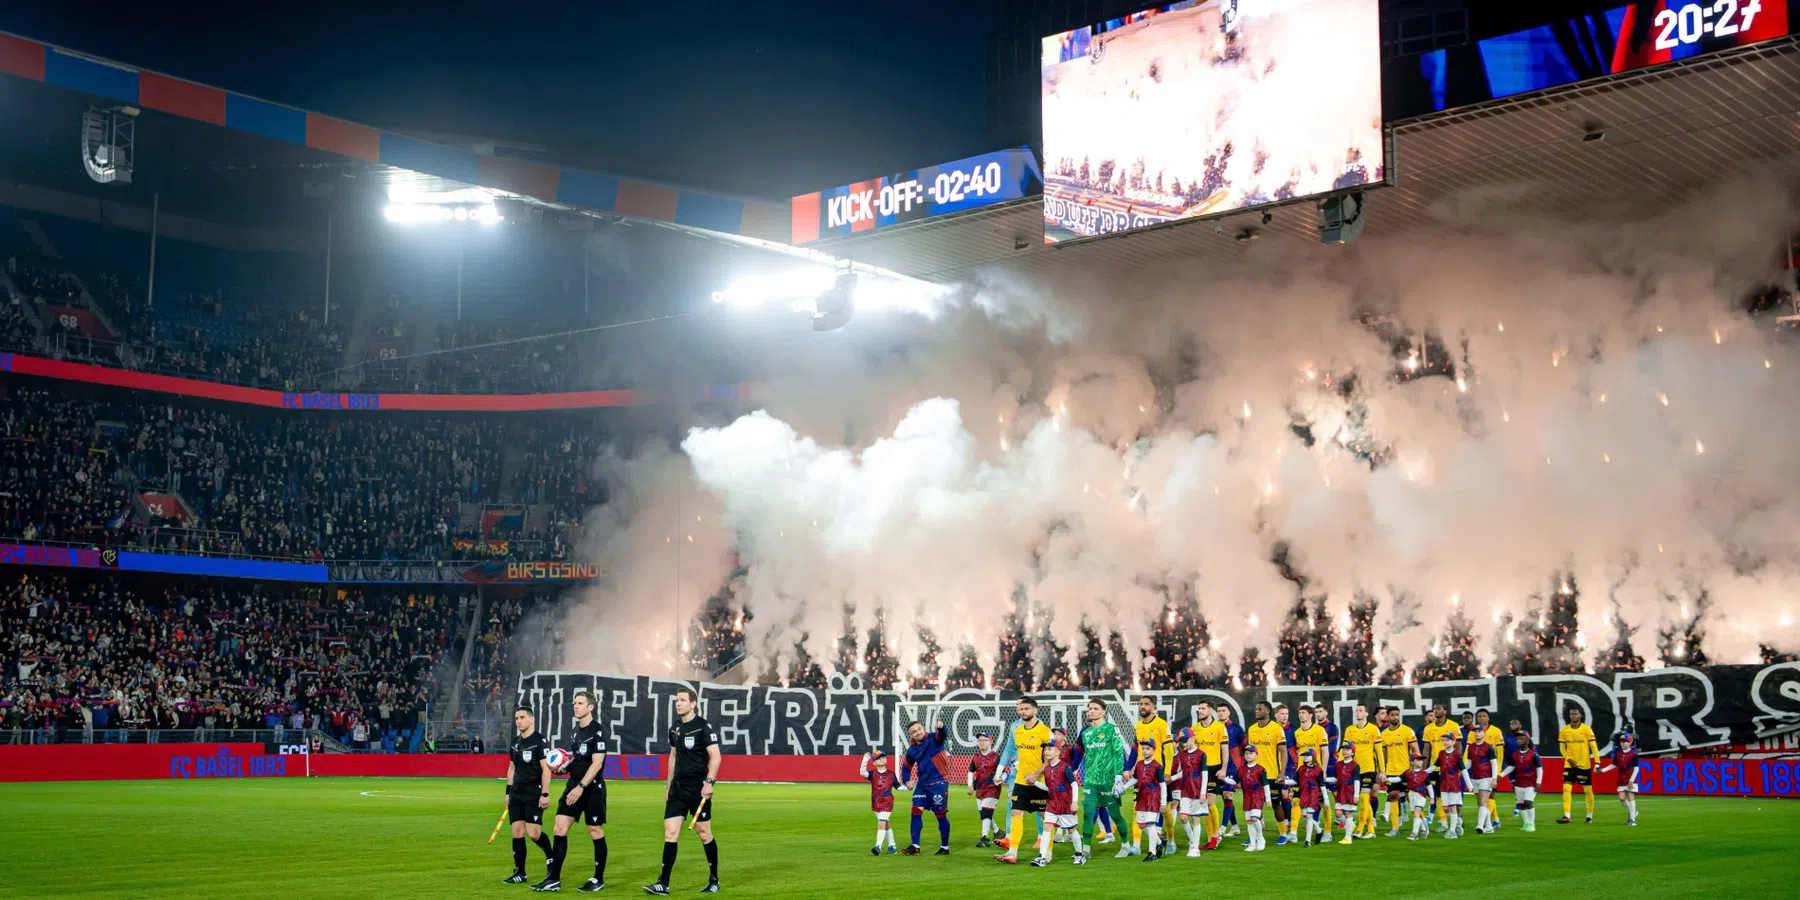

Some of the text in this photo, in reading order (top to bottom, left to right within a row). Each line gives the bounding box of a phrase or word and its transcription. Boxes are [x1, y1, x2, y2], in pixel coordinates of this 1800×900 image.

[828, 162, 1001, 228] KICK-OFF: -02:40
[59, 314, 78, 328] G8
[282, 392, 299, 409] FC
[302, 392, 344, 409] BASEL
[1, 543, 20, 562] FC
[25, 545, 72, 566] BASEL
[1515, 666, 1731, 758] DR
[170, 755, 286, 778] FC BASEL 1893
[601, 756, 659, 778] SEL 1893
[1637, 761, 1653, 792] C
[1662, 761, 1752, 793] BASEL
